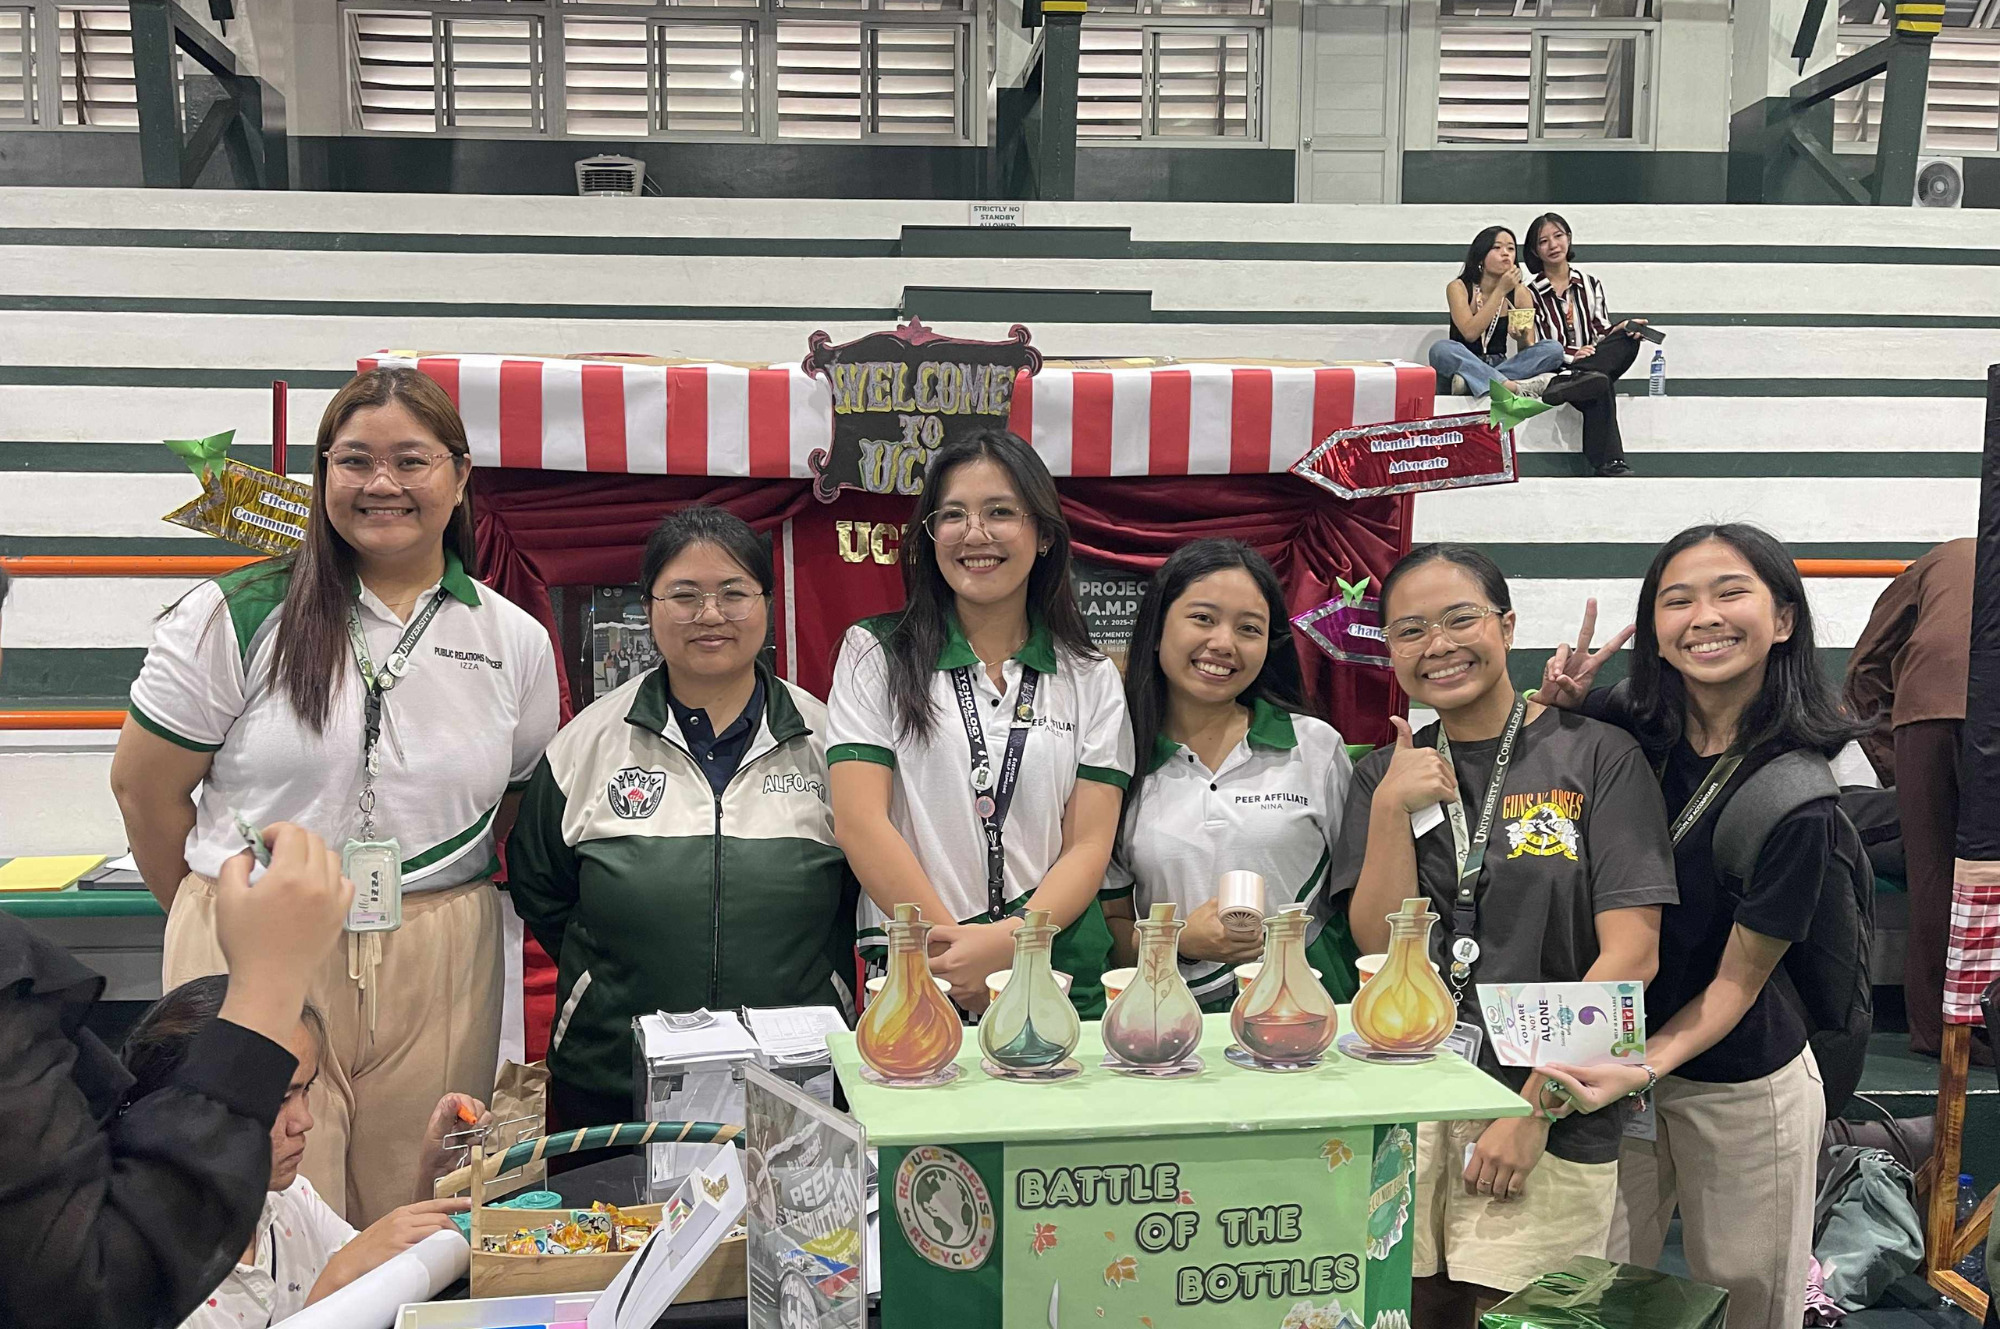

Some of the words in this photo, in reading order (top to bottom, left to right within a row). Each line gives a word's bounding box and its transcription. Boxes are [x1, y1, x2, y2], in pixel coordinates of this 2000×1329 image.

[824, 361, 1016, 415] WELCOME
[899, 414, 945, 449] TO
[1371, 436, 1415, 452] Mental
[1419, 431, 1463, 447] Health
[858, 438, 943, 496] UC
[1389, 457, 1448, 474] Advocate
[233, 507, 305, 538] Communic
[260, 491, 309, 516] Effectiv
[835, 520, 908, 565] UC
[1079, 581, 1149, 596] PROJEC
[398, 610, 433, 657] UNIVERSITY
[434, 646, 454, 658] PUBLIC
[454, 650, 485, 662] RELATIONS
[460, 661, 479, 670] IZZA
[956, 668, 982, 745] SYCHOLOGY
[1474, 782, 1499, 843] UNIVERSITY
[1496, 702, 1524, 766] CORDILLERAS
[1235, 795, 1261, 804] PEER
[1264, 793, 1309, 806] AFFILIATE
[1502, 793, 1534, 819] GUNS
[1551, 789, 1584, 820] ROSES
[370, 870, 379, 901] IZZA
[1517, 1003, 1525, 1023] ARE
[1539, 999, 1551, 1042] ALONE
[789, 1157, 835, 1206] PEER
[899, 1149, 941, 1200] REDUCE
[958, 1161, 992, 1230] REUSE
[1017, 1163, 1180, 1209] BATTLE
[782, 1153, 859, 1240] RECRUITMENT
[909, 1226, 983, 1265] RECYCLE
[1136, 1211, 1199, 1252] OF
[1218, 1204, 1302, 1247] THE
[1176, 1253, 1360, 1306] BOTTLES
